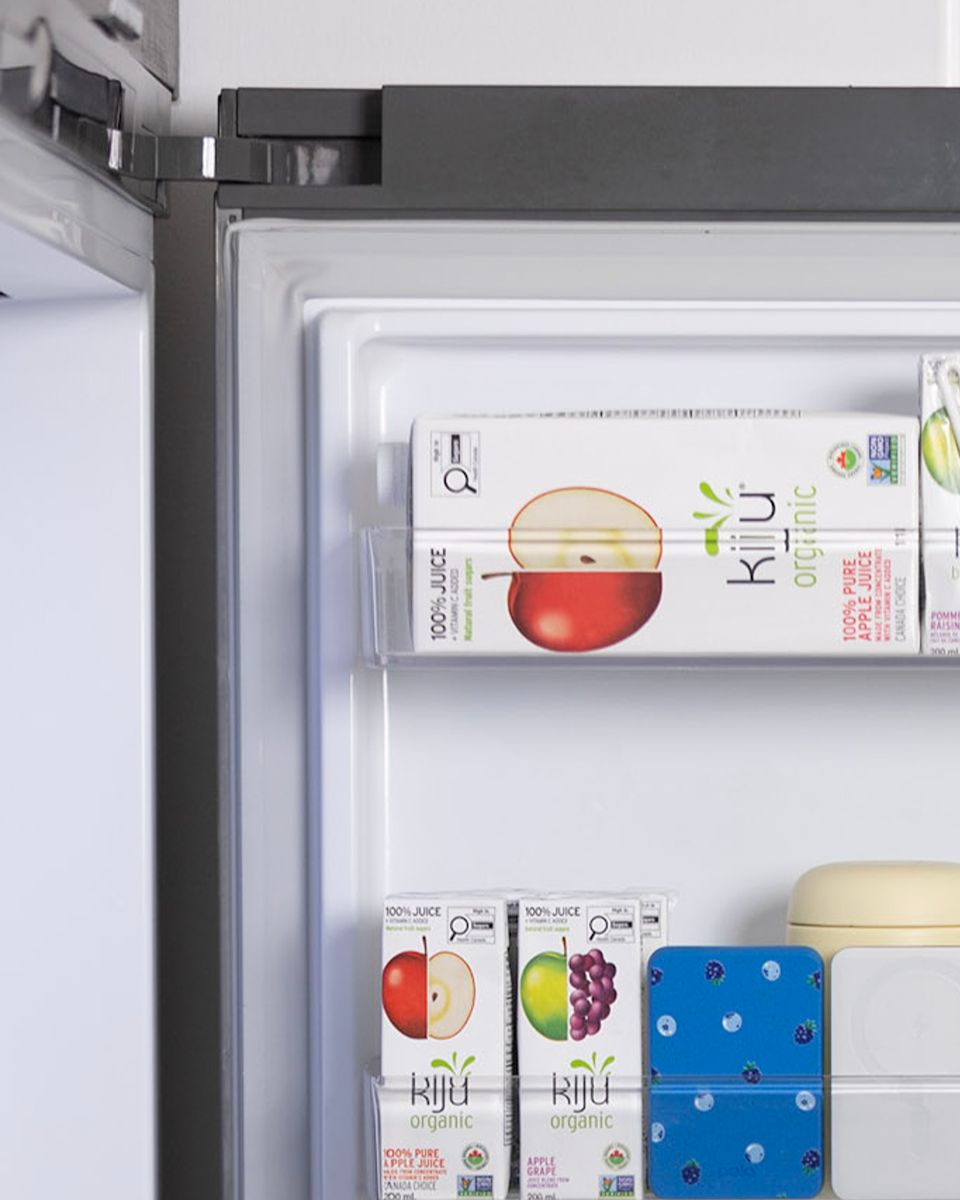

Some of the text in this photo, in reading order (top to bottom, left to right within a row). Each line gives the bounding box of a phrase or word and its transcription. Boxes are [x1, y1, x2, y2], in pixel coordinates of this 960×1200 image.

[431, 547, 446, 641] 100% JUICE
[842, 558, 857, 642] 100% PURE
[858, 550, 872, 642] APPLE JUICE
[894, 576, 906, 642] CANADA CHOICE
[930, 622, 960, 630] RAISIN
[385, 906, 442, 917] 100% JUICE
[525, 906, 581, 917] 100% JUICE
[411, 1072, 468, 1114] kiju
[552, 1072, 609, 1114] kiju
[410, 1112, 473, 1133] organic
[550, 1111, 614, 1132] organic
[384, 1148, 440, 1158] 100% PURE
[384, 1158, 445, 1168] APPLE JUICE
[527, 1156, 555, 1166] APPLE
[527, 1166, 556, 1176] GRAPE
